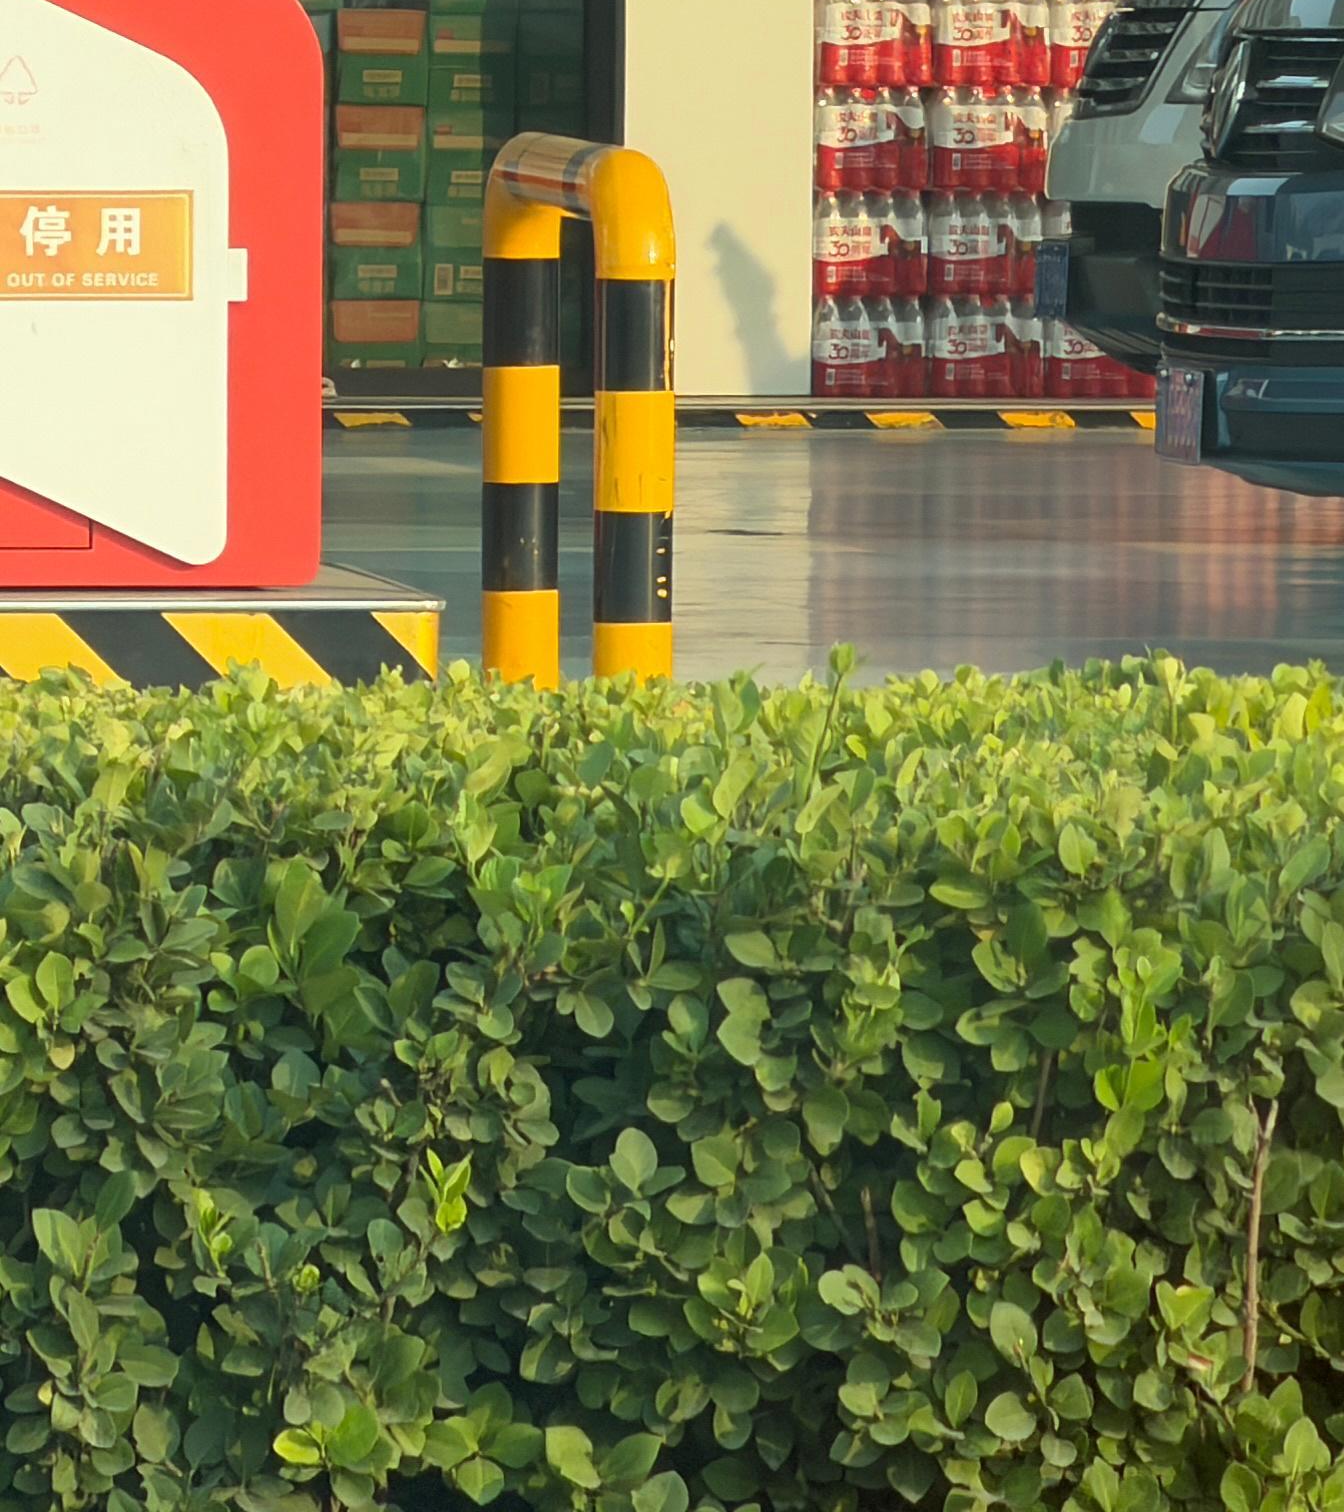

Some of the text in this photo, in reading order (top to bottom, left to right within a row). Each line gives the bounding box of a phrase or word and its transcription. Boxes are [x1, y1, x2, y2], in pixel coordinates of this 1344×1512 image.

[19, 205, 141, 257] 停用
[6, 272, 160, 288] OUT OF SERVICE
